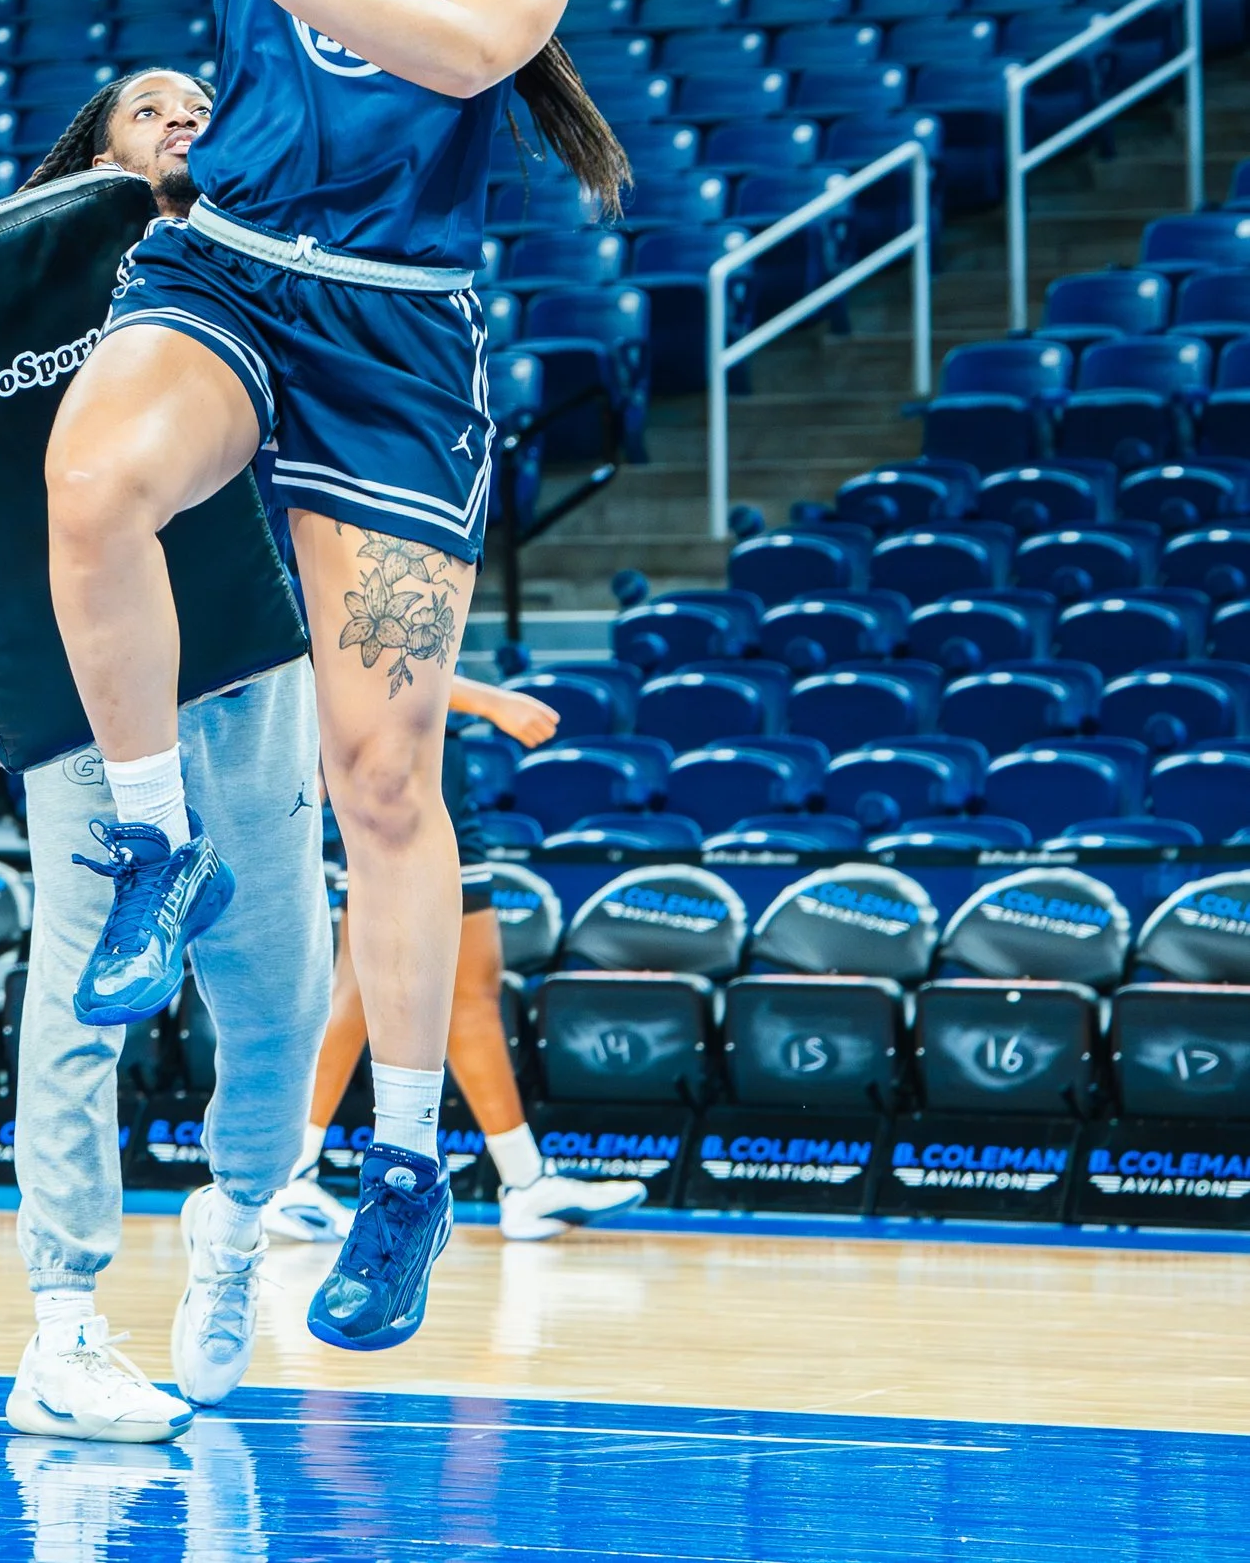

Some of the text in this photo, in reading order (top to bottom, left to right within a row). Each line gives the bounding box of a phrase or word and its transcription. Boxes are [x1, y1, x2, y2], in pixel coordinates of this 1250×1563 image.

[591, 1033, 632, 1065] 14
[985, 1036, 1024, 1073] 16
[732, 1162, 833, 1183] AVIATION
[923, 1169, 1027, 1190] AVIATION
[1120, 1176, 1228, 1199] AVIATION
